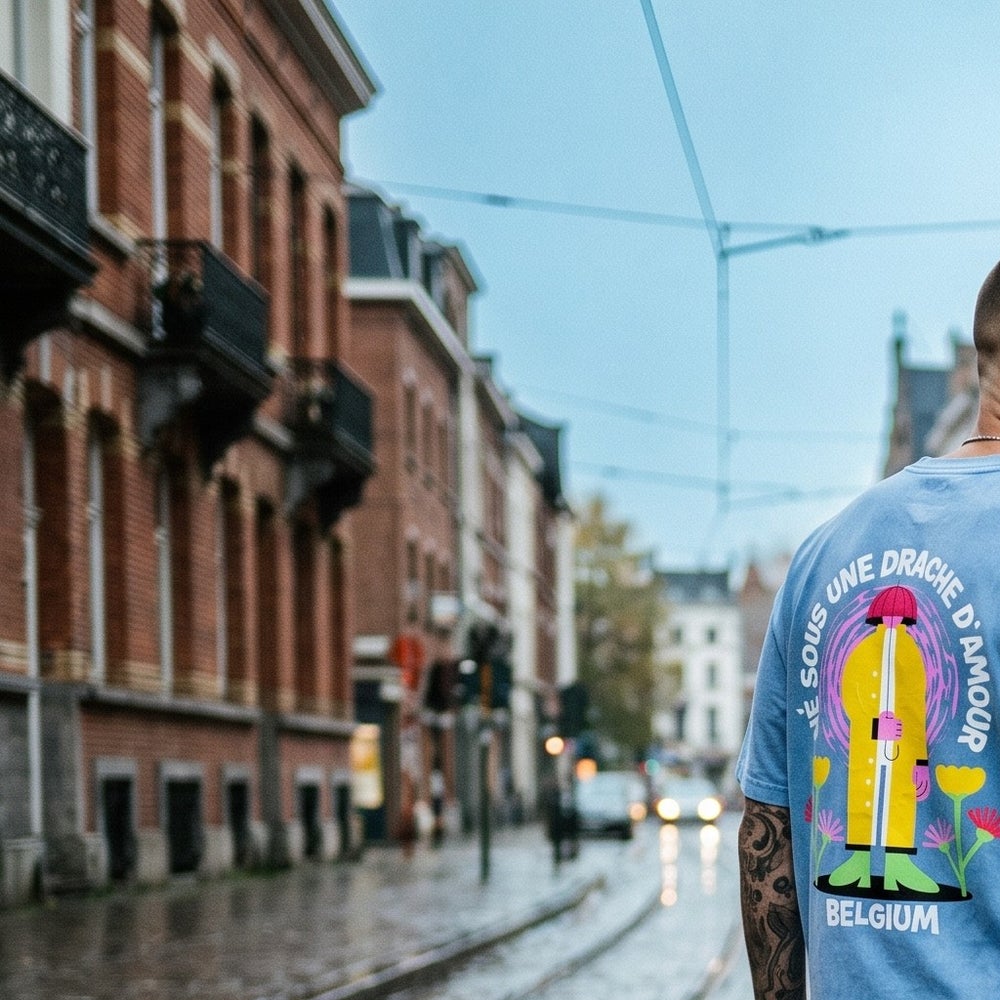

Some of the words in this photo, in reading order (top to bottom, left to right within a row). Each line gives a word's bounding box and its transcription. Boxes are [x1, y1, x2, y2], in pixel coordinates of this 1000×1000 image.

[800, 602, 827, 688] SOUS
[826, 553, 875, 604] UNE
[880, 548, 964, 609] DRACHE
[952, 603, 992, 753] D'AMOUR
[826, 899, 939, 935] BELGIUM
